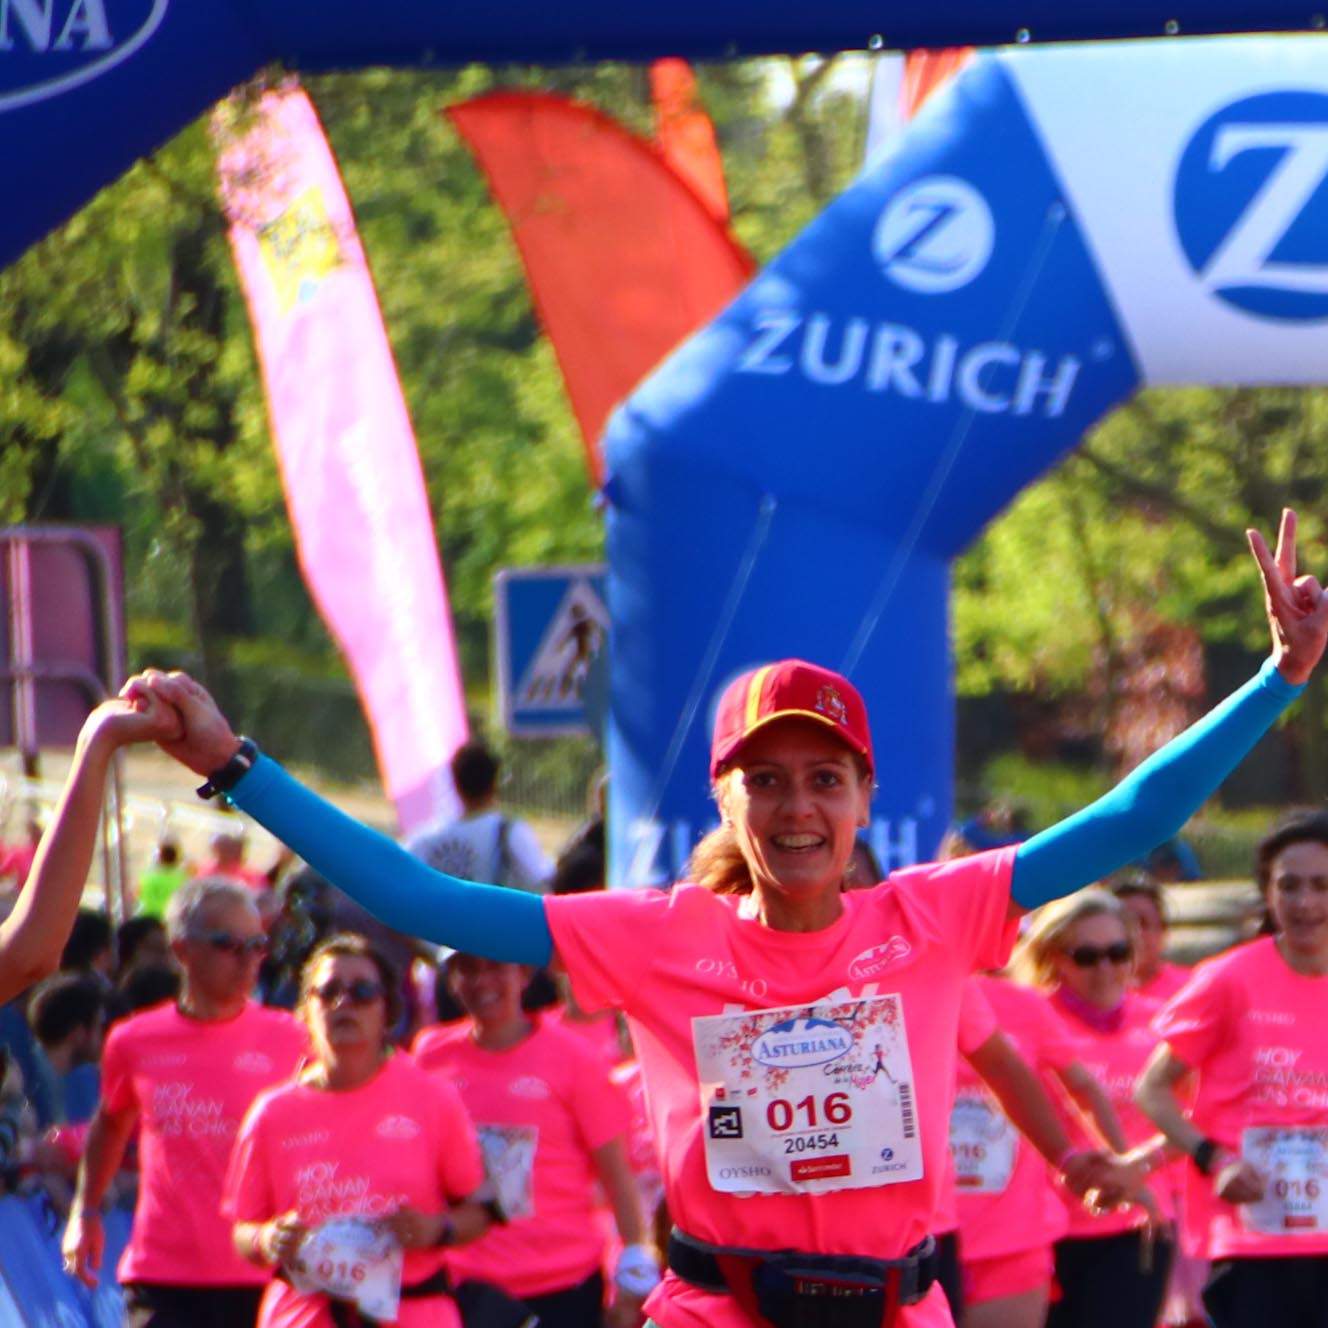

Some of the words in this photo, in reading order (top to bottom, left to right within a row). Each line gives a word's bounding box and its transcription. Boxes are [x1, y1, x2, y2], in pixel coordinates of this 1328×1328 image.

[736, 310, 1081, 418] ZURICH
[759, 1037, 847, 1060] ASTURIANA
[766, 1092, 853, 1132] 016
[784, 1133, 840, 1154] 20454
[719, 1165, 773, 1181] OYSHO
[1275, 1179, 1320, 1199] 016
[317, 1260, 366, 1282] 016
